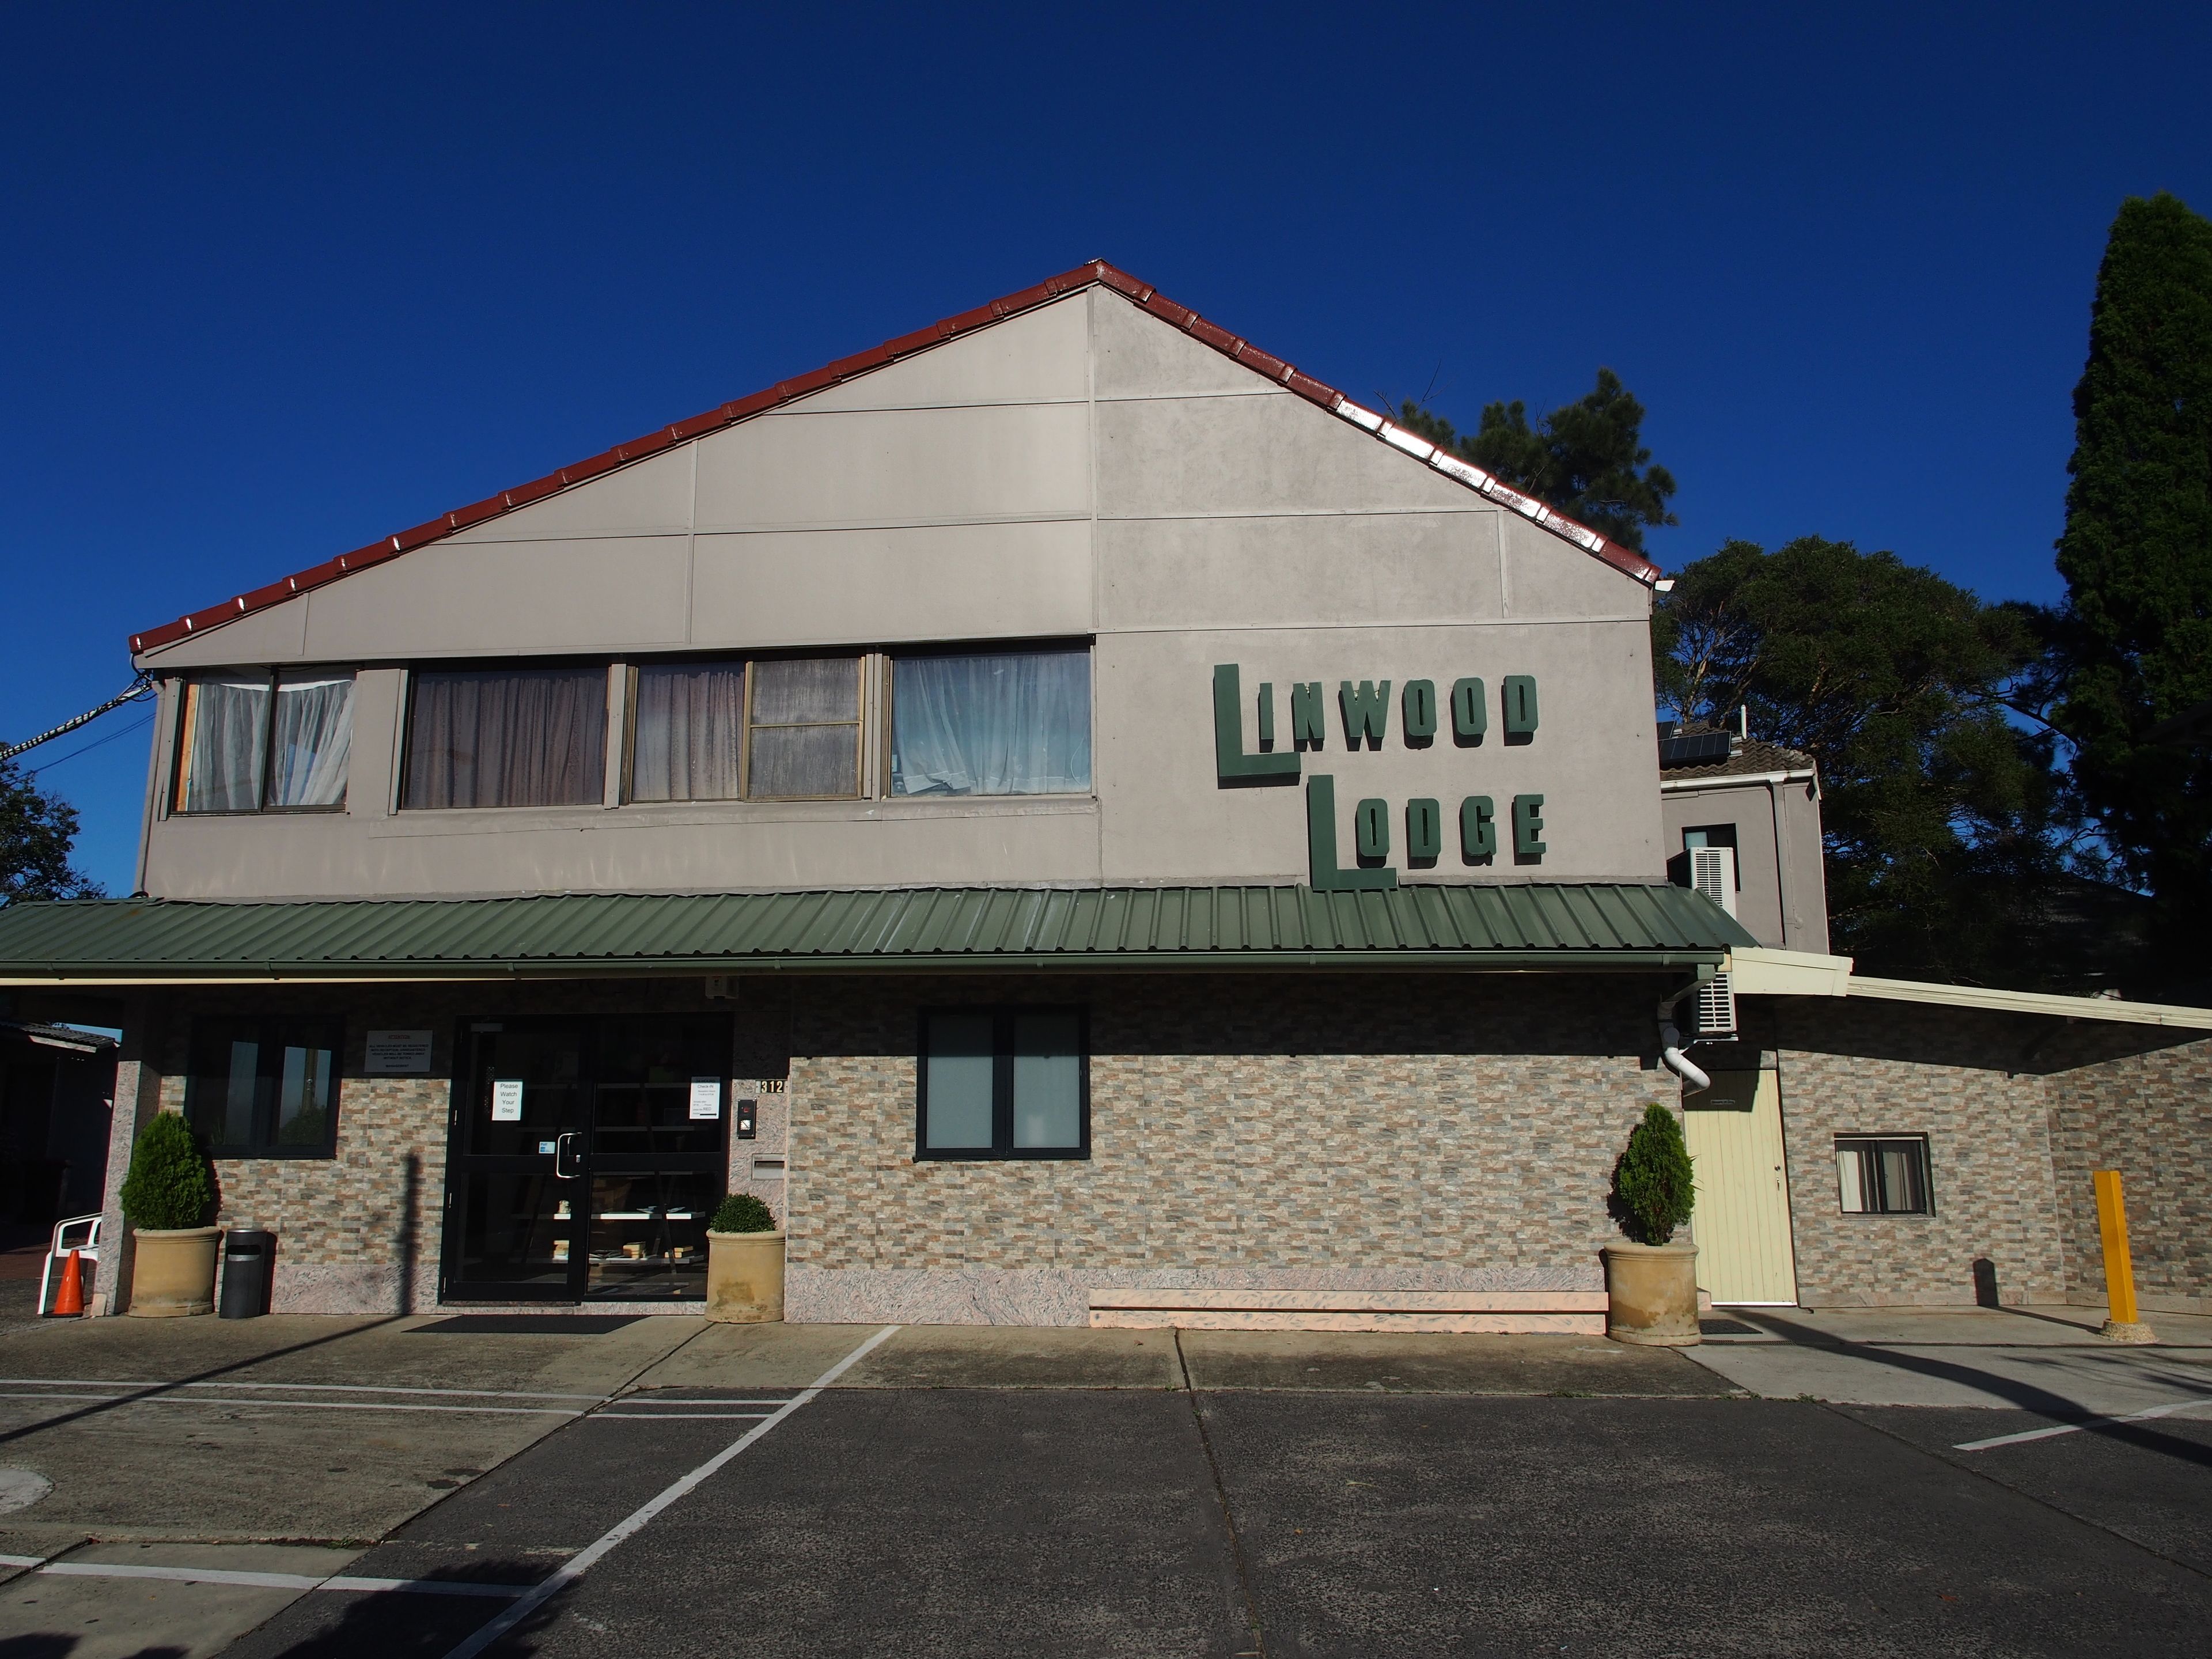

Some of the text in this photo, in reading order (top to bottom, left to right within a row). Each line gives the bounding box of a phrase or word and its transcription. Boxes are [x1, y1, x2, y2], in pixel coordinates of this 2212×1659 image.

[1213, 663, 1539, 782] LINWOOD
[1308, 774, 1546, 891] LODGE
[761, 1081, 783, 1093] 312
